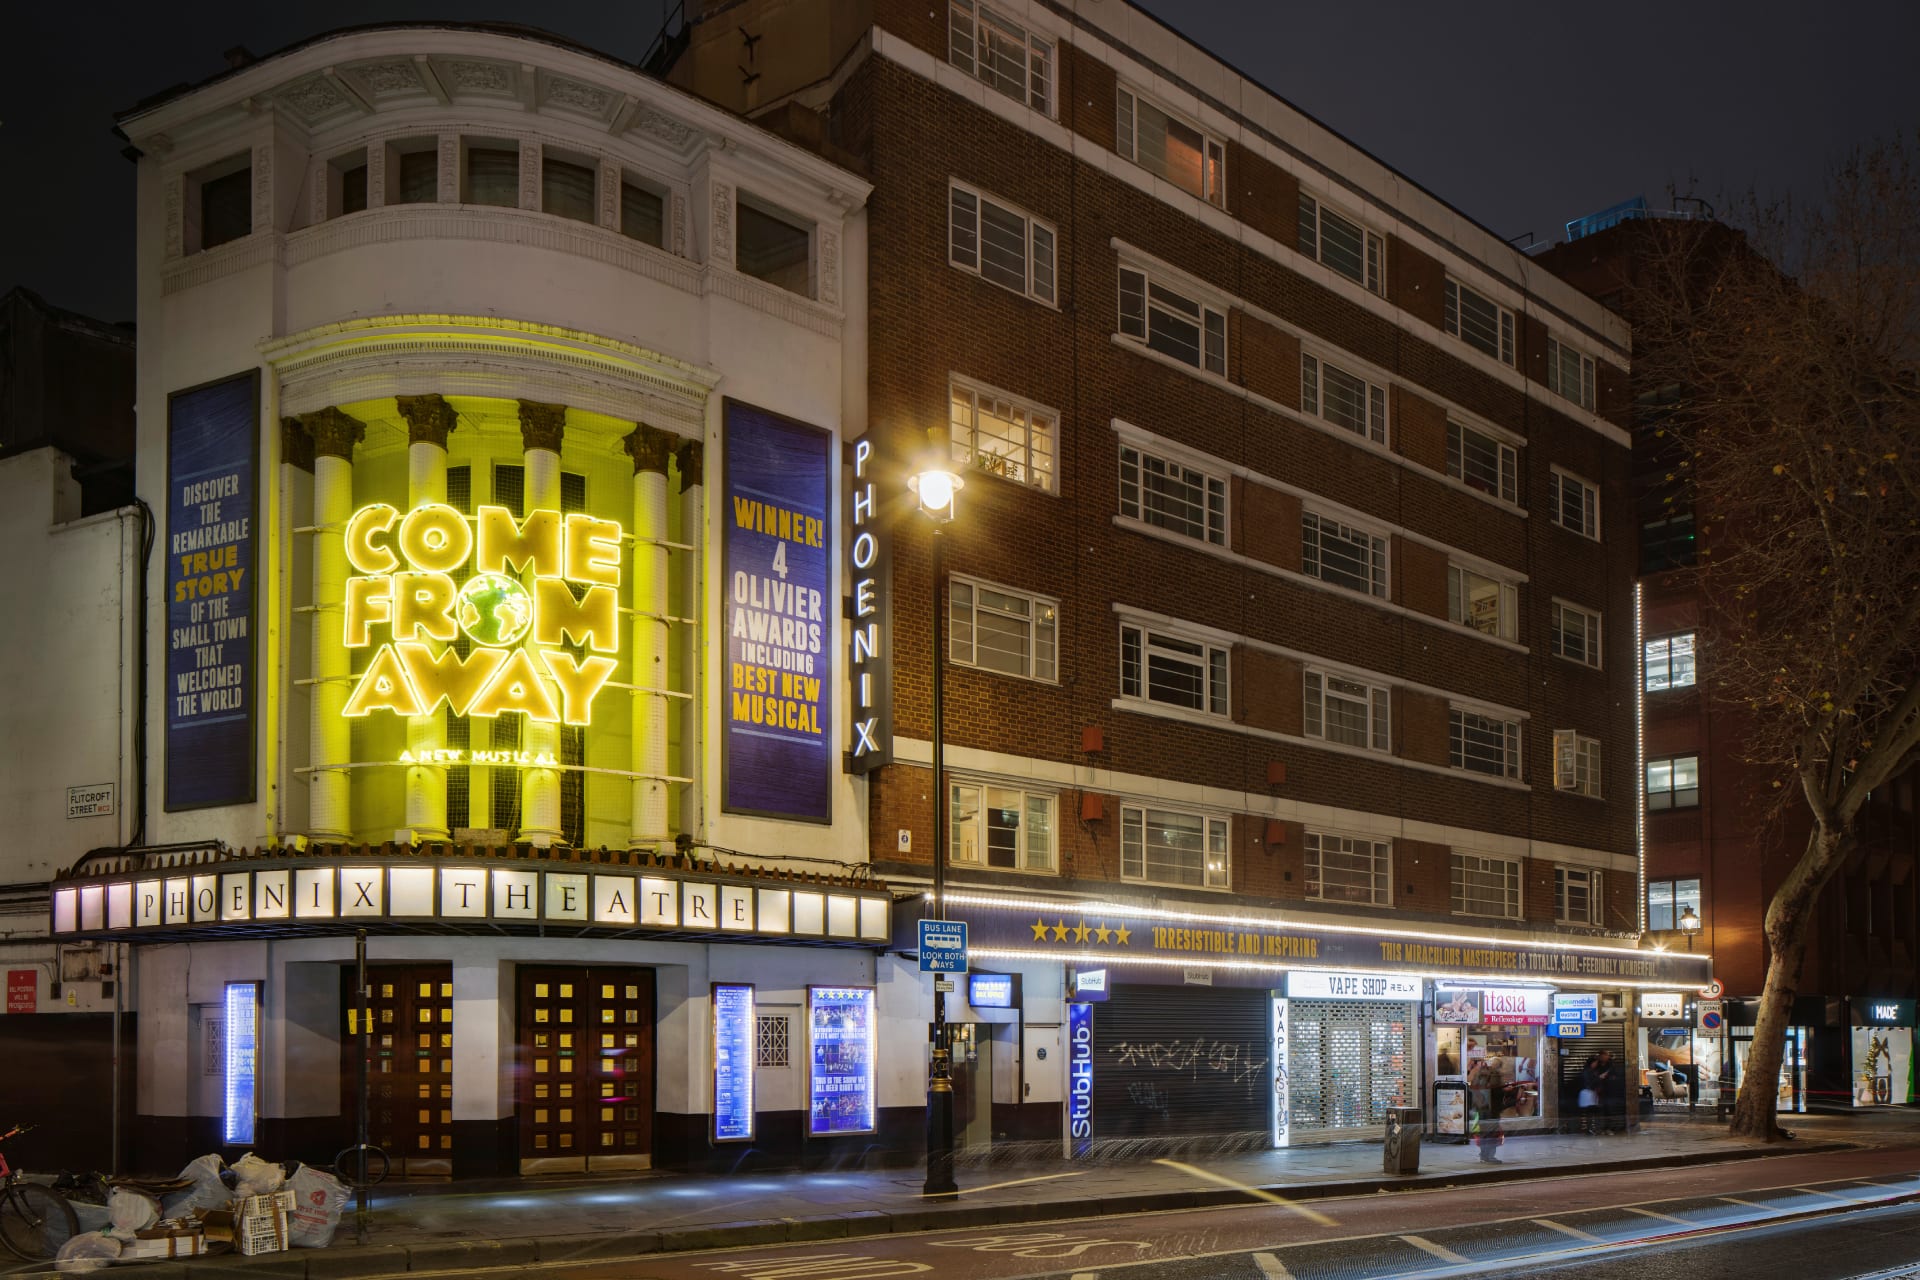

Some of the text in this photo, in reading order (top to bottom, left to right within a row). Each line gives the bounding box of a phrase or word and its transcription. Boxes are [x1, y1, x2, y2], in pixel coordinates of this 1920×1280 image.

[184, 474, 240, 507] DISCOVER
[200, 501, 221, 525] THE
[733, 496, 824, 548] WINNER!
[173, 518, 248, 554] REMARKABLE
[344, 503, 622, 587] COME
[181, 545, 238, 576] TRUE
[772, 541, 788, 579] 4
[175, 568, 245, 602] STORY
[734, 571, 822, 622] OLIVIER
[854, 440, 879, 757] PHOENIX
[191, 597, 229, 623] OF THE
[343, 571, 619, 653] FROM
[173, 616, 247, 649] SMALL TOWN
[732, 607, 821, 654] AWARDS
[195, 644, 223, 668] THAT
[741, 641, 814, 675] INCLUDING
[177, 664, 242, 694] WELCOMED
[341, 642, 619, 726] AWAY
[732, 663, 820, 703] BEST NEW
[177, 687, 242, 717] THE WORLD
[732, 692, 822, 734] MUSICAL
[399, 749, 558, 765] A NEW MUSICAL
[70, 792, 110, 804] FLITCROFT
[70, 804, 97, 815] STREET
[144, 881, 745, 922] PHOENIX THEATRE
[924, 924, 962, 933] BUS LANE
[1238, 933, 1260, 954] AND
[922, 952, 964, 960] LOOK BOTH
[1405, 944, 1460, 966] MIRACULOUS
[1463, 948, 1516, 968] MASTERPIECE
[1519, 952, 1526, 970] IS
[1328, 977, 1415, 995] VAPE SHOP RELX
[1876, 1005, 1896, 1019] MADE
[1277, 1006, 1285, 1066] VAPE
[1072, 1028, 1090, 1138] StubHub
[927, 1233, 1152, 1258] BUS
